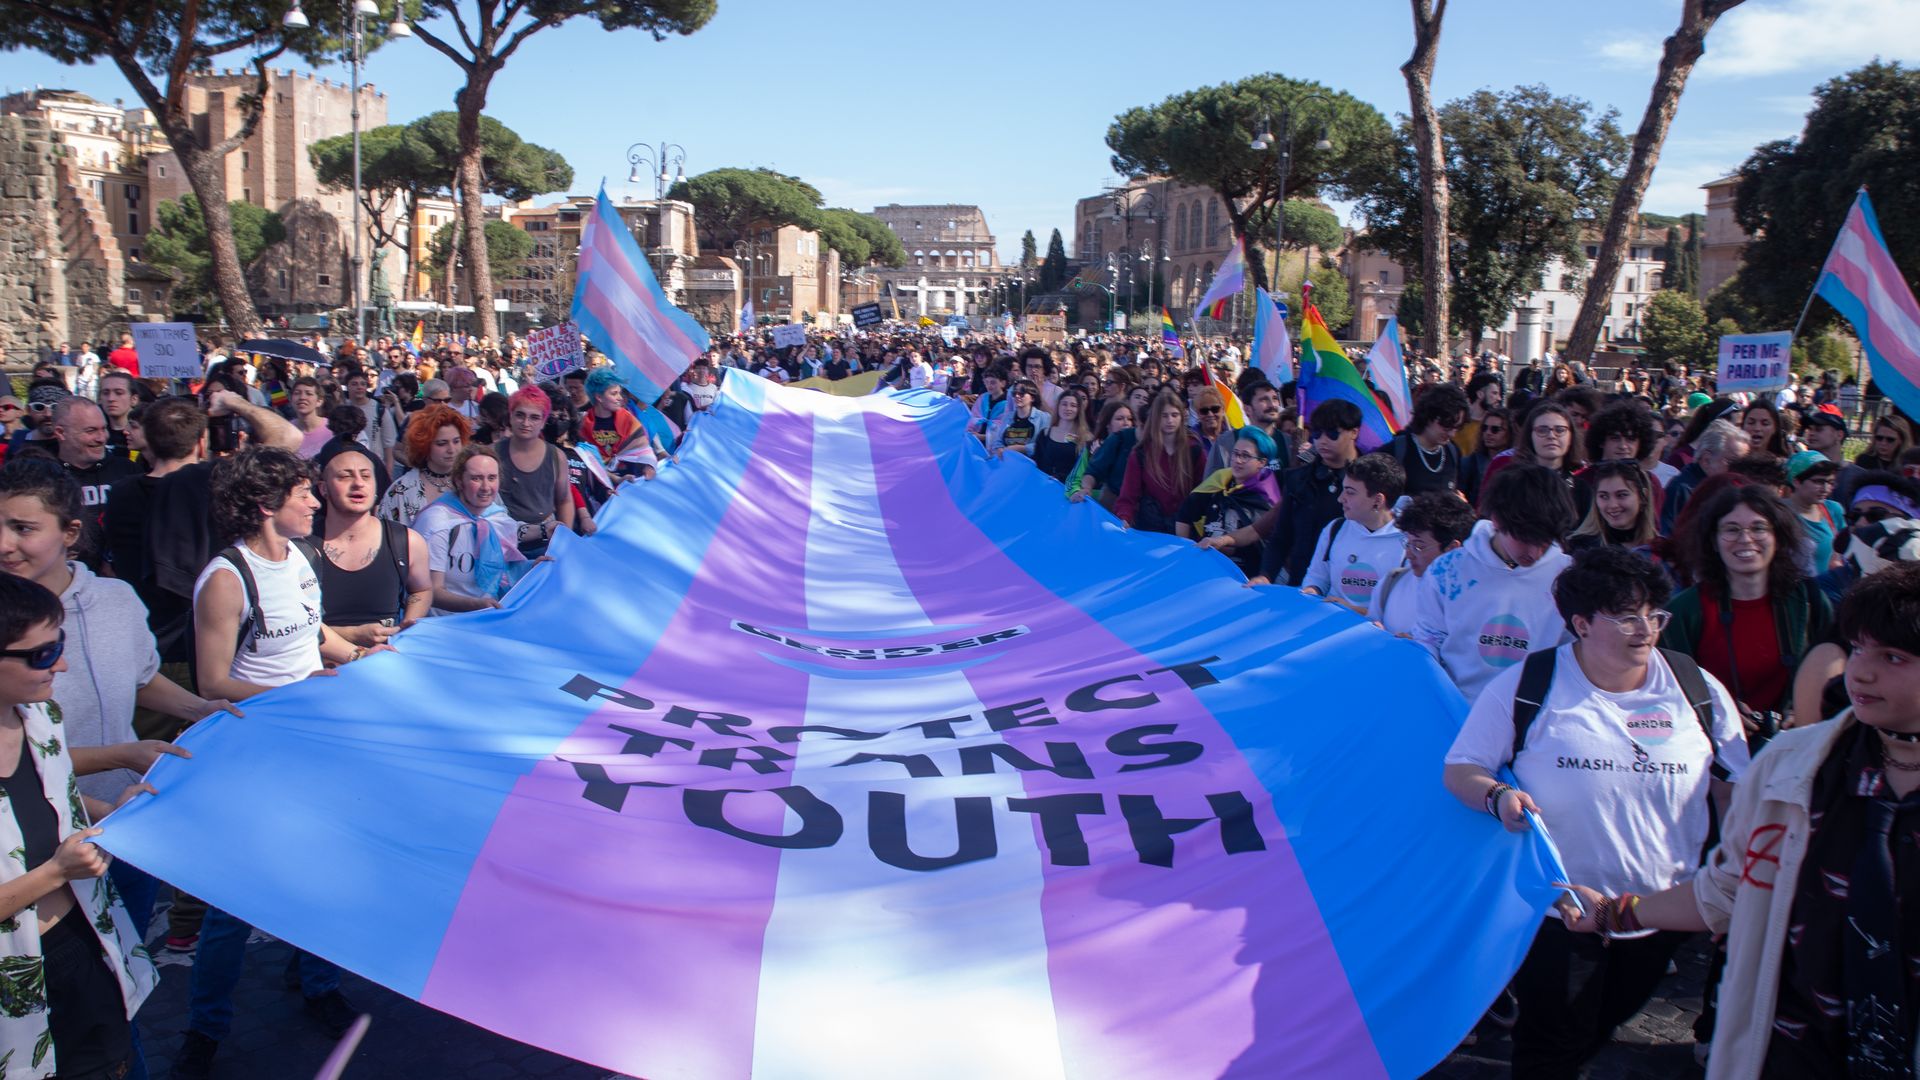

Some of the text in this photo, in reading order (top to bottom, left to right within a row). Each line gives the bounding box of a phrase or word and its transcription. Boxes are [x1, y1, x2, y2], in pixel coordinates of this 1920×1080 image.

[528, 327, 554, 343] NON
[530, 331, 576, 355] UN PESCE
[1732, 343, 1780, 359] PER ME
[1727, 364, 1767, 379] PARLO
[254, 623, 298, 640] SMASH
[736, 621, 1026, 660] GENDER
[1479, 634, 1529, 651] GENDER
[558, 655, 1222, 744] PROTECT
[1626, 719, 1674, 730] GENDER
[607, 722, 1205, 780] TRANS
[1556, 756, 1614, 772] SMASH
[1615, 763, 1631, 773] the
[553, 754, 1267, 872] YOUTH
